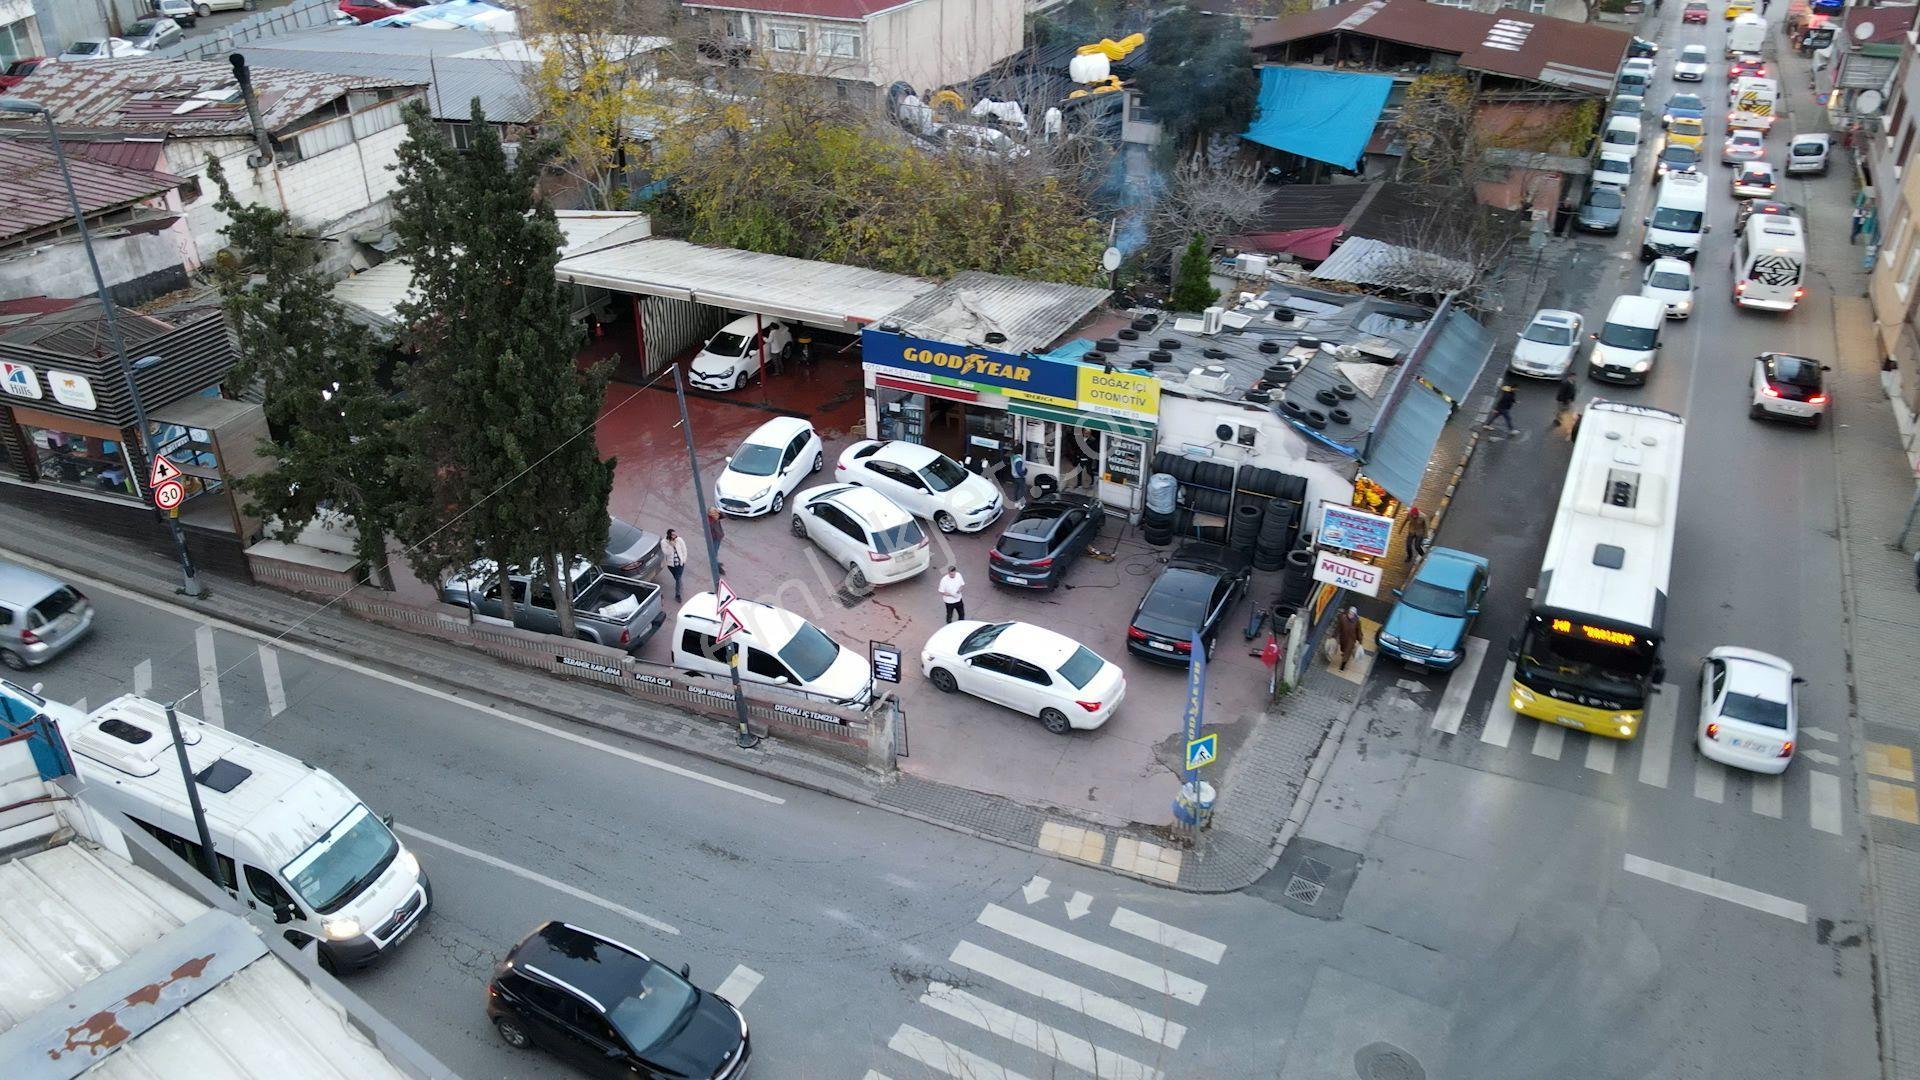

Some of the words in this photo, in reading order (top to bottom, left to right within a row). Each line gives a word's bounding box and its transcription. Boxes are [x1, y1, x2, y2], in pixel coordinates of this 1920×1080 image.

[162, 487, 177, 502] 30
[1321, 559, 1375, 584] MUTLU
[635, 673, 656, 684] PASTA
[688, 685, 706, 696] BOYA
